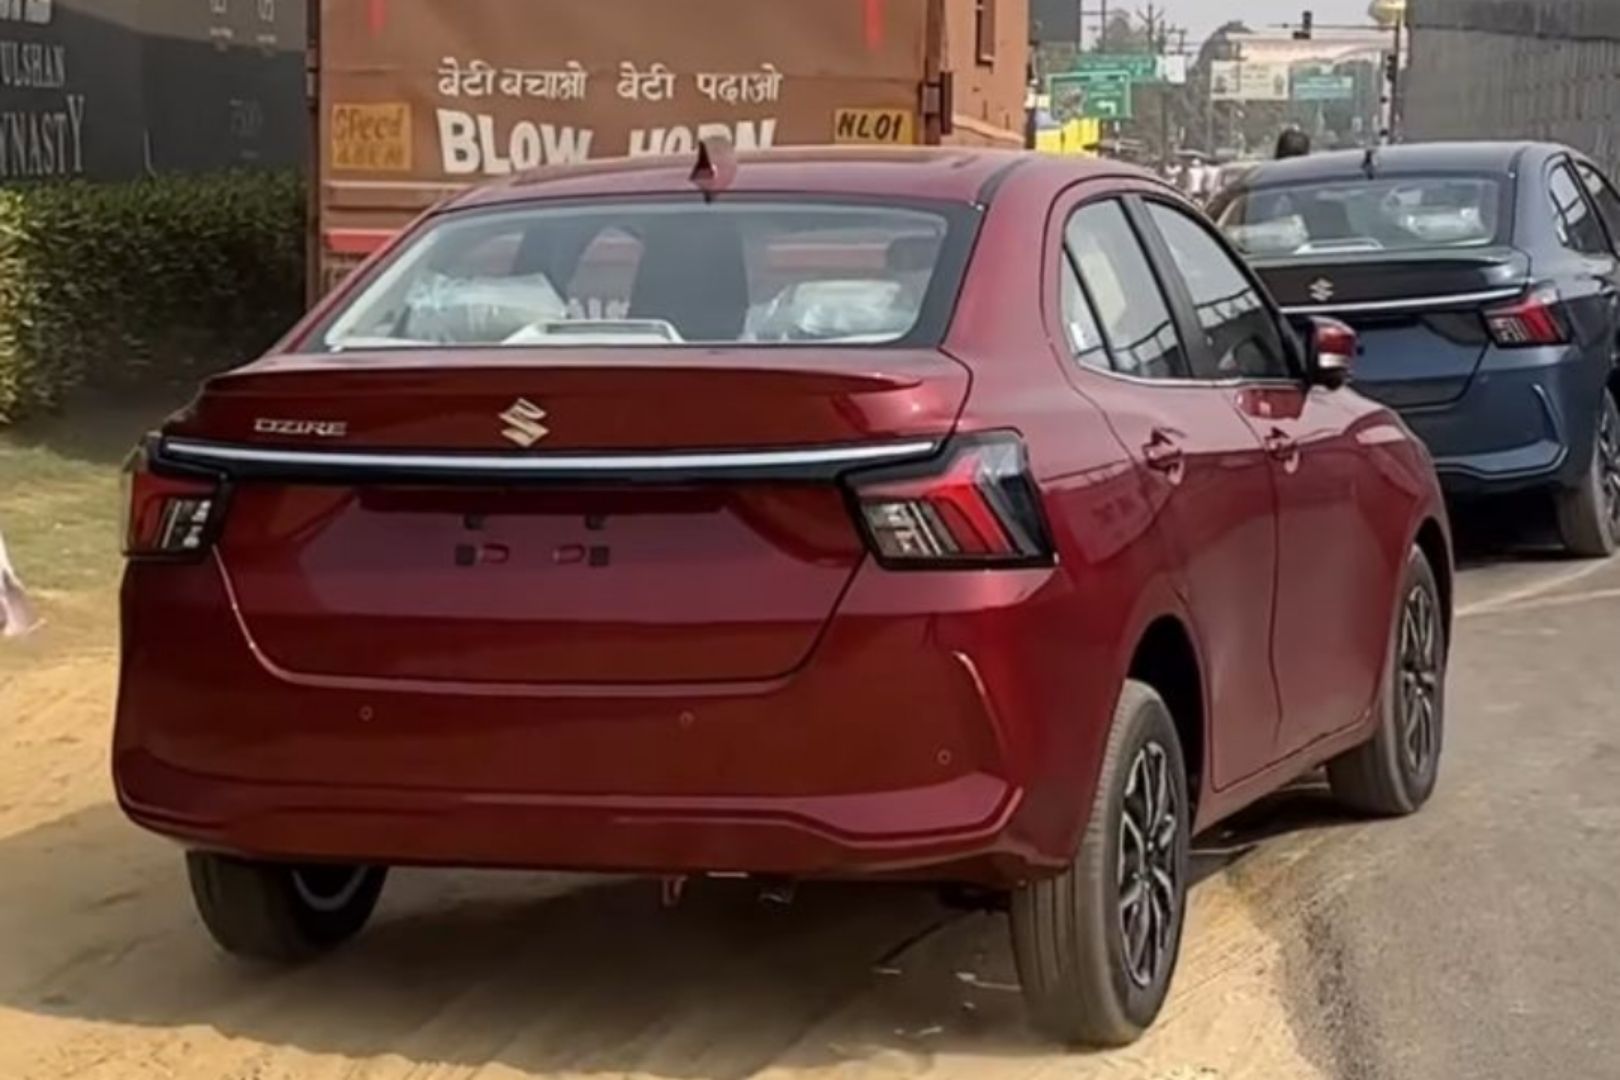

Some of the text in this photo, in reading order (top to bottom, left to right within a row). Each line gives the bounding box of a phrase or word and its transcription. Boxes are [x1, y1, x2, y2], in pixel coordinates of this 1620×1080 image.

[438, 57, 497, 96] बेटी
[617, 61, 676, 100] बेटी
[437, 108, 593, 175] BLOW
[838, 112, 903, 141] NL01
[254, 418, 347, 437] DZIRE
